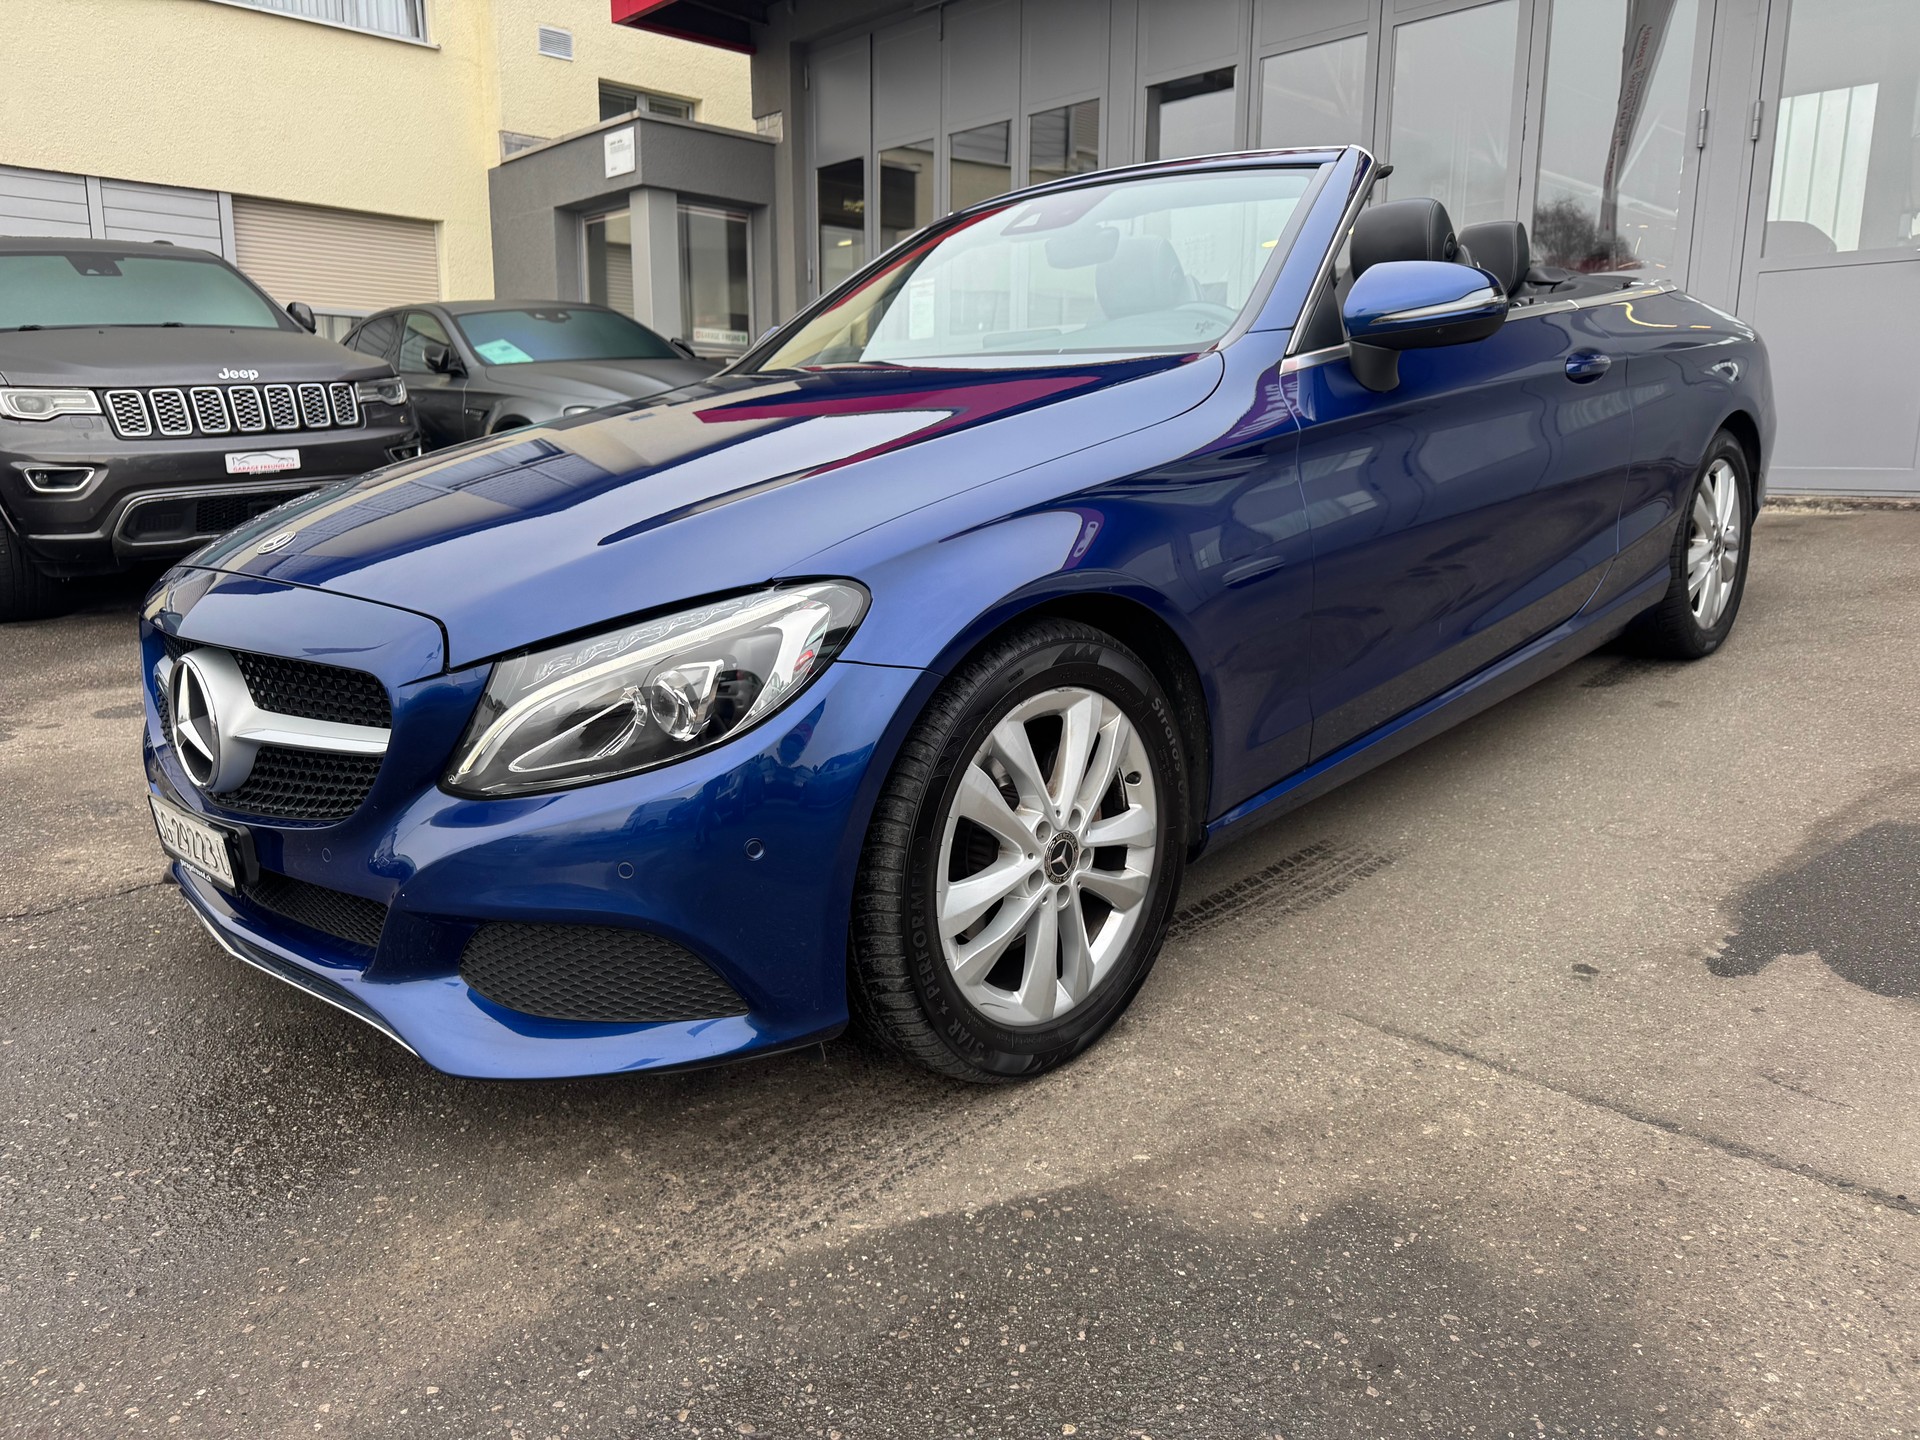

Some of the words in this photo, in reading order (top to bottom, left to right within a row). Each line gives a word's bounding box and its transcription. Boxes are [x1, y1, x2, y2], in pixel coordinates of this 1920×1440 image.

[219, 368, 259, 380] Jeep
[1151, 697, 1181, 772] Stratos
[911, 862, 940, 999] PERFORMER
